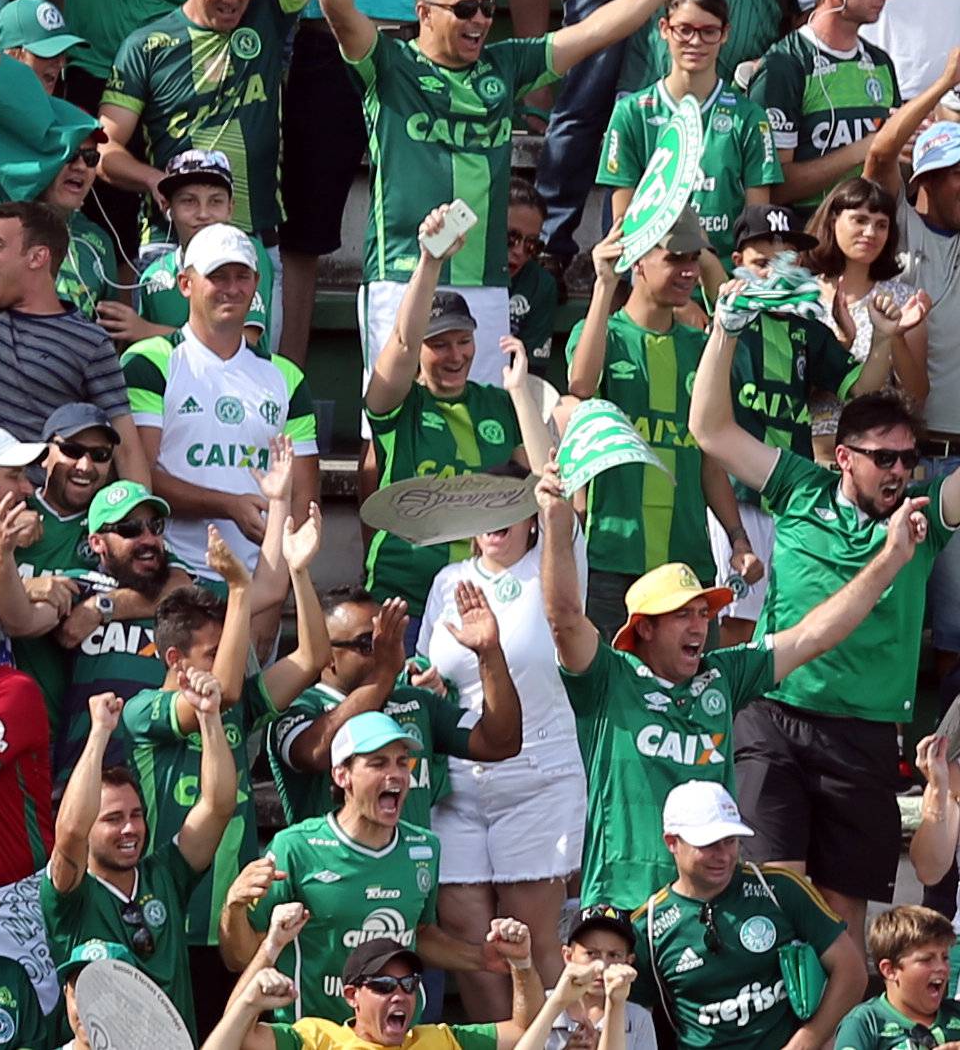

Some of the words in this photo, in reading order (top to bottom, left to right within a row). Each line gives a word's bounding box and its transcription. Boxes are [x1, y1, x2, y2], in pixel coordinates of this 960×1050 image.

[407, 112, 512, 148] CAIXA
[698, 213, 730, 232] PECÓ
[637, 724, 726, 766] CAIX
